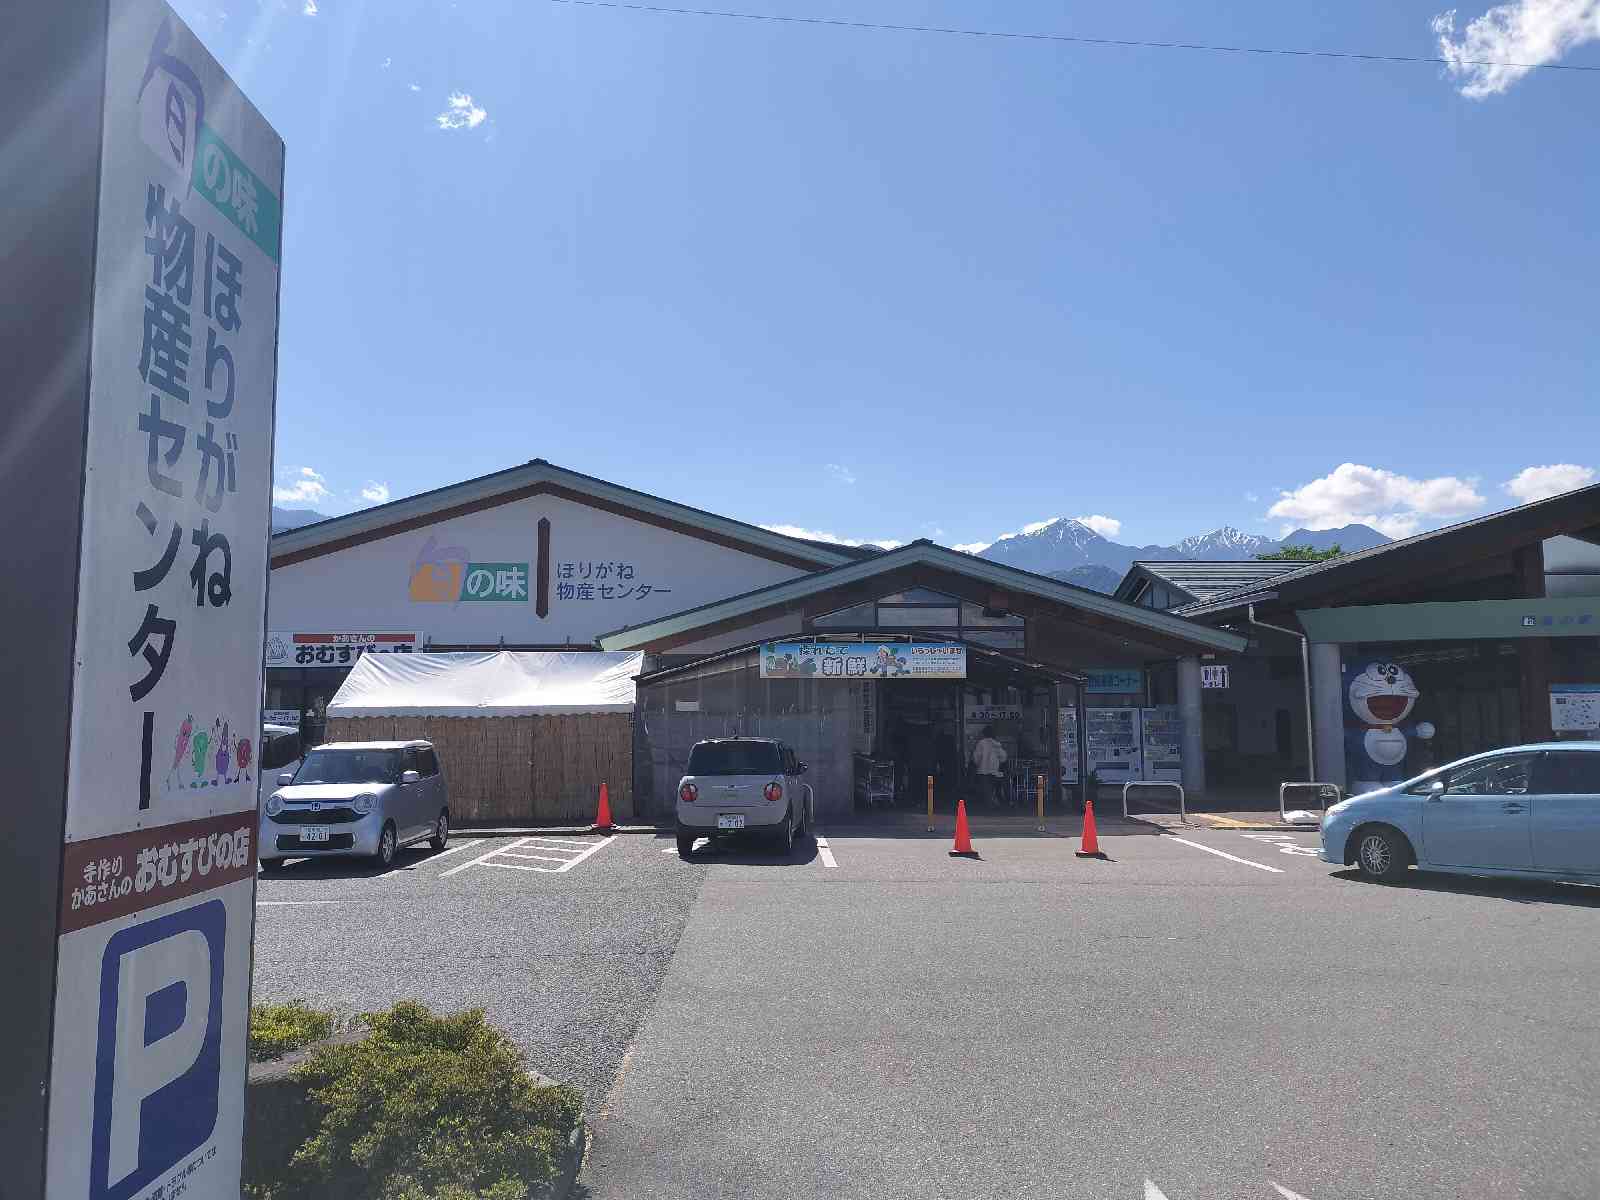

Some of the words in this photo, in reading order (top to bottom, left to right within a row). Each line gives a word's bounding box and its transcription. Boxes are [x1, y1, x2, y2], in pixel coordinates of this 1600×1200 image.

[189, 231, 244, 607] ほりがね
[128, 182, 196, 811] 物産センター
[556, 561, 635, 581] ほりがね
[556, 582, 672, 601] 物産センター
[822, 656, 867, 677] 新鮮
[83, 855, 123, 883] 手作り
[134, 826, 252, 894] おむすびの店
[71, 876, 133, 910] かあさんの
[107, 929, 212, 1190] P
